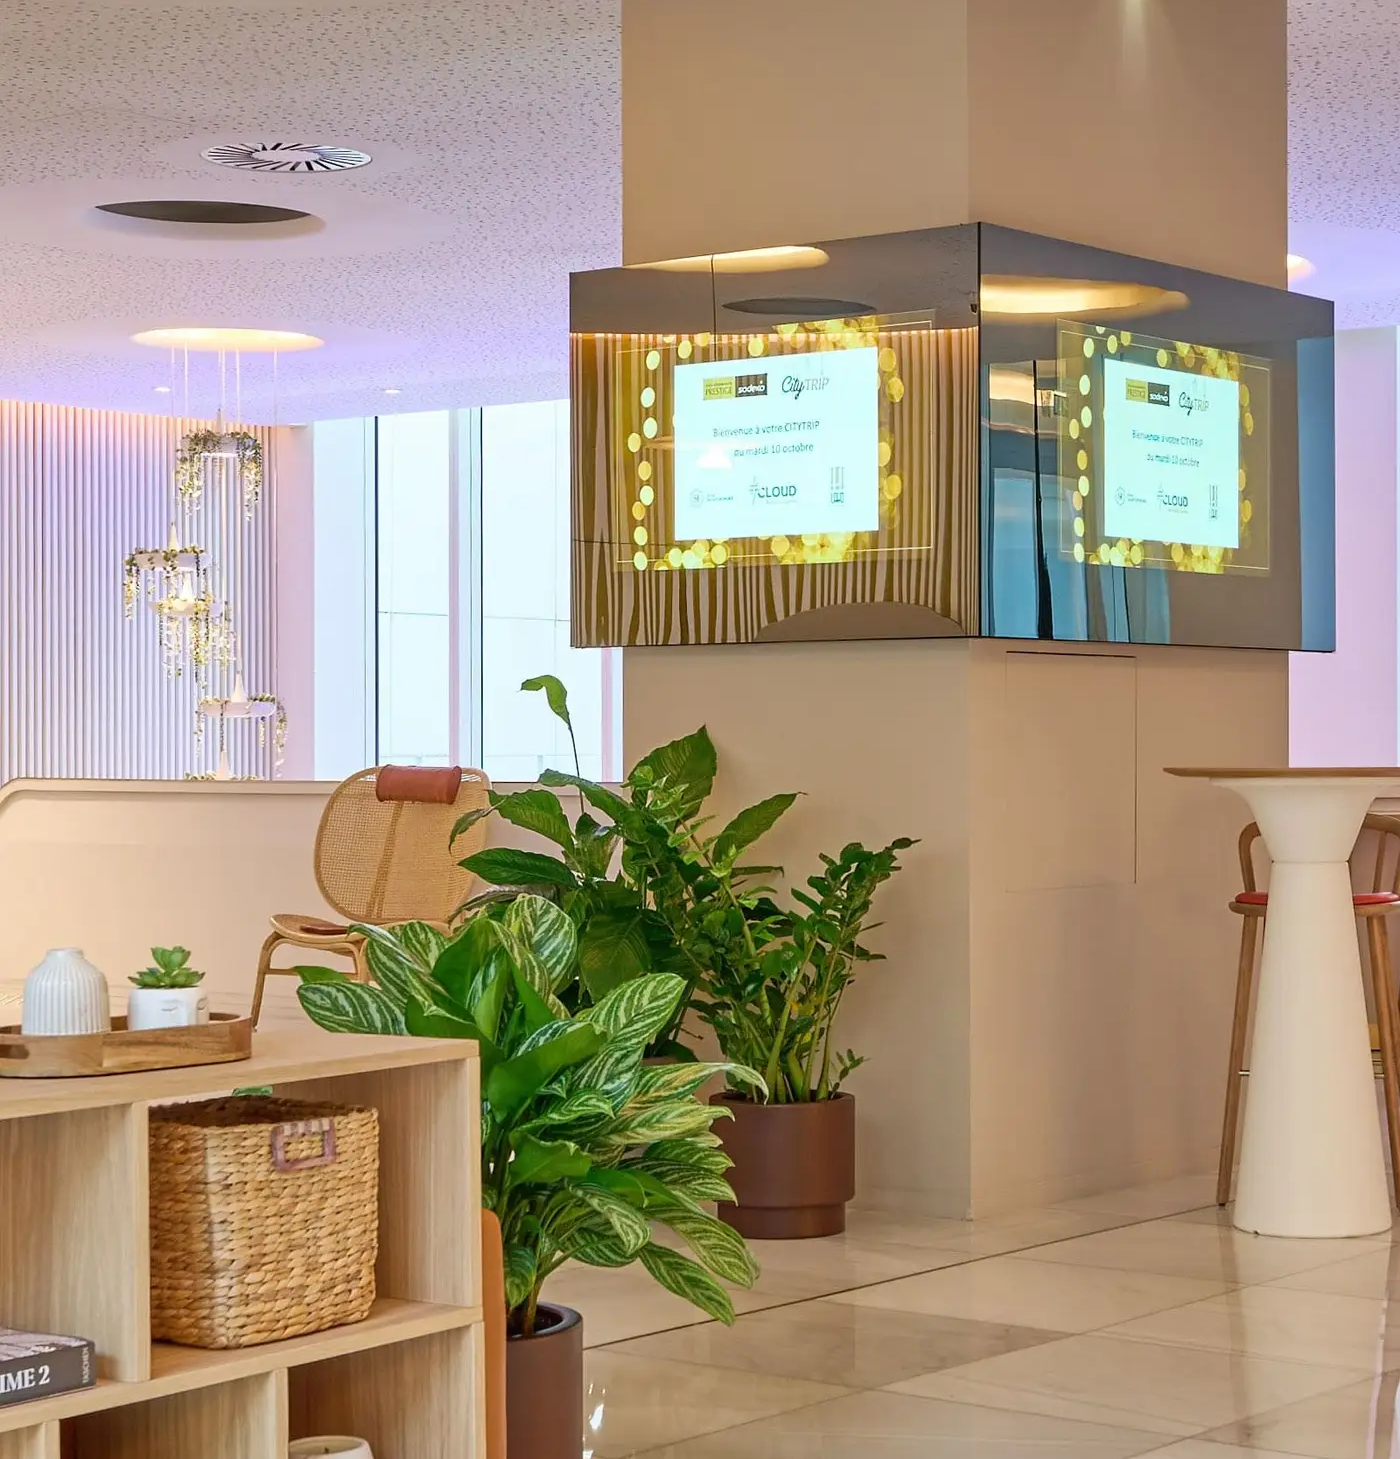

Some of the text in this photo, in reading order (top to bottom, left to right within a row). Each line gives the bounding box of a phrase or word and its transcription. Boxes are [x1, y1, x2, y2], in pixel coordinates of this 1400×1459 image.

[738, 380, 766, 394] sodexo
[761, 424, 783, 435] votre
[784, 420, 820, 433] CITYTRIP
[771, 444, 781, 454] 10
[782, 442, 814, 453] octobre
[38, 1364, 51, 1385] 2
